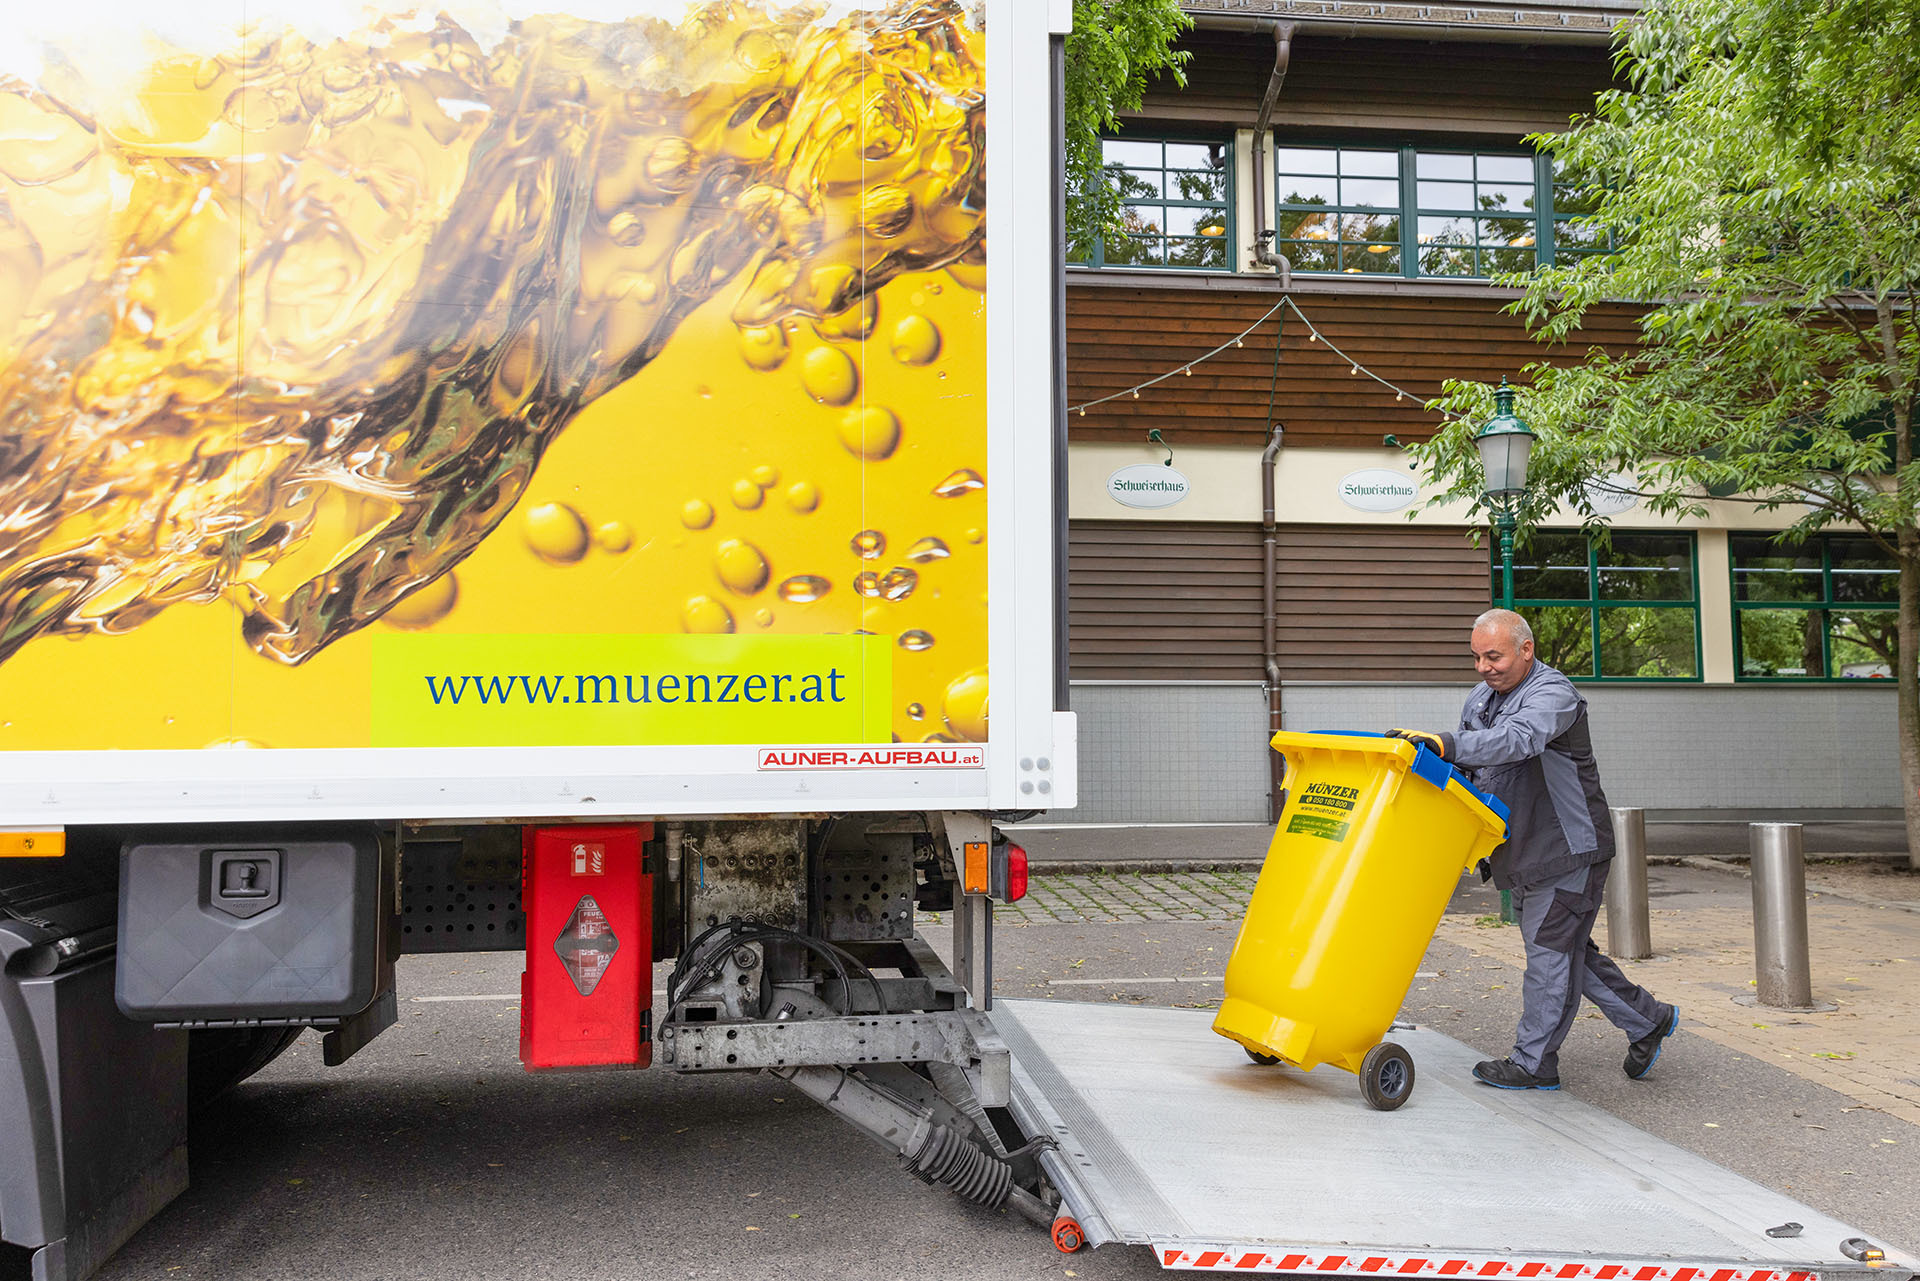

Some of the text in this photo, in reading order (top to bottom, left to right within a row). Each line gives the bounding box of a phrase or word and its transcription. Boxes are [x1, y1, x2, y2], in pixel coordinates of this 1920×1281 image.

[1113, 479, 1184, 492] Schweizerhaus
[1344, 484, 1413, 496] Schweizerhaus
[424, 668, 846, 704] www.muenzer.at
[763, 751, 980, 766] AUNER-AUFBAU.at
[1305, 782, 1359, 800] MÜNZER
[1313, 796, 1324, 804] 050
[1301, 806, 1347, 817] www.muenzer.at
